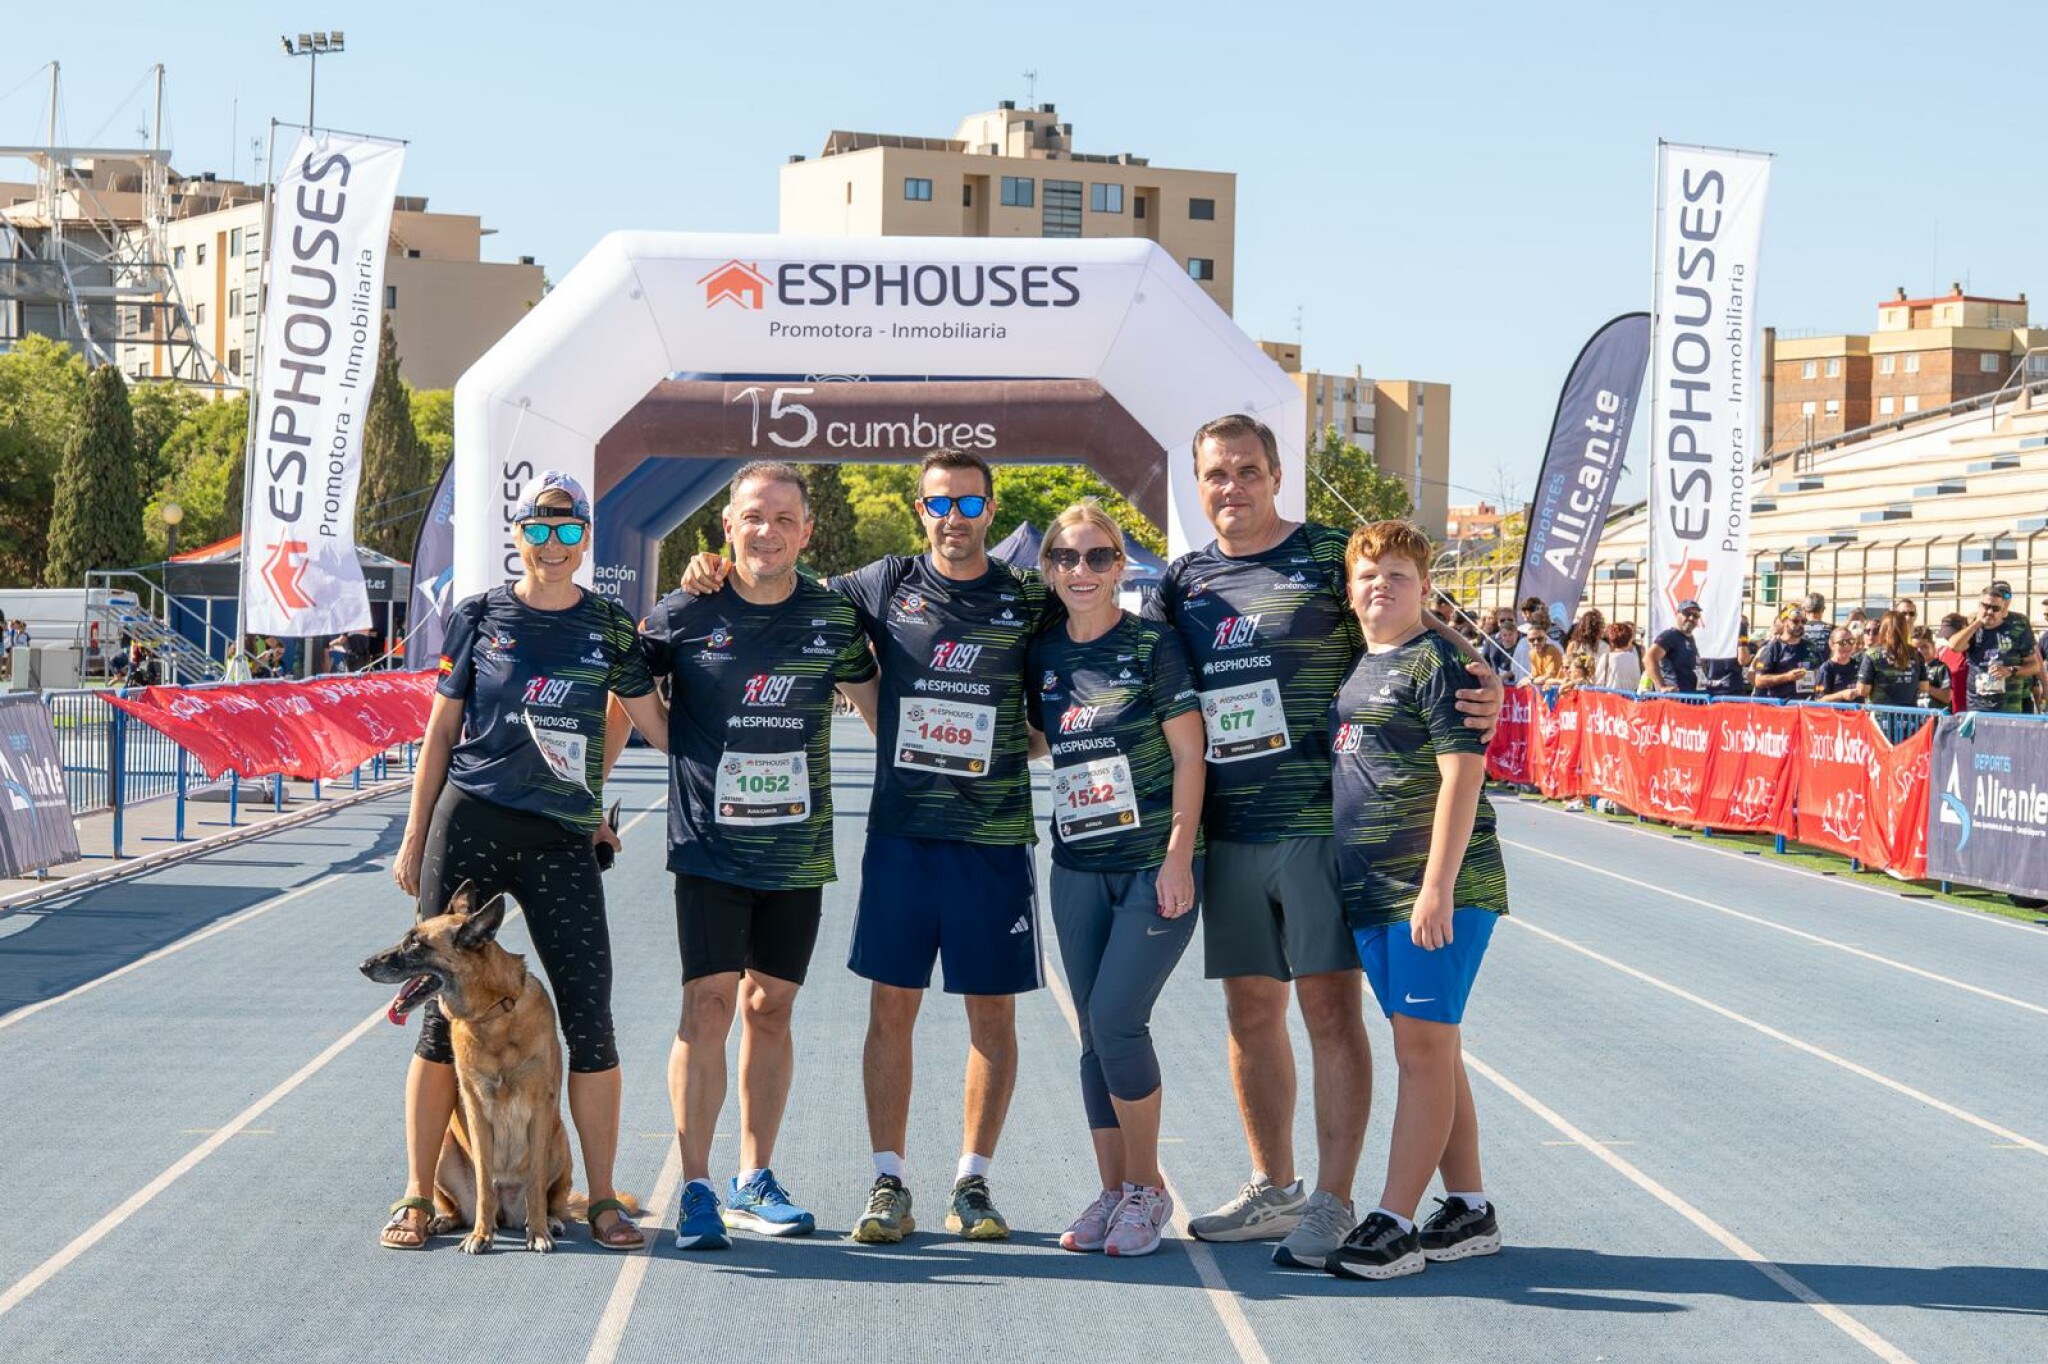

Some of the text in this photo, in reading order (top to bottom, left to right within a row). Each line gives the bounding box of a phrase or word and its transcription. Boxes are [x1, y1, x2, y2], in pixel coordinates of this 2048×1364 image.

[777, 263, 1080, 307] ESPHOUSES
[267, 152, 351, 523] ESPHOUSES
[769, 321, 872, 339] Promotora
[892, 321, 1007, 339] Inmobiliaria
[1726, 263, 1745, 402] Inmobiliaria
[1668, 168, 1725, 541] ESPHOUSES
[320, 412, 351, 537] Promotora
[339, 249, 372, 388] Inmobiliaria
[731, 386, 997, 449] 15 cumbres
[1544, 389, 1620, 578] Alicante
[1722, 428, 1744, 552] Promotora
[1530, 472, 1565, 567] DEPORTES
[594, 564, 636, 581] ación
[595, 580, 621, 595] pol
[802, 646, 836, 655] Santander
[1214, 655, 1272, 672] ESPHOUSES
[928, 679, 991, 695] ESPHOUSES
[743, 716, 804, 729] ESPHOUSES
[1220, 709, 1255, 731] 677
[918, 722, 972, 745] 1469
[1060, 736, 1116, 753] ESPHOUSES
[736, 775, 790, 793] 1052
[1068, 784, 1116, 809] 1522
[1974, 773, 2048, 825] Alicante
